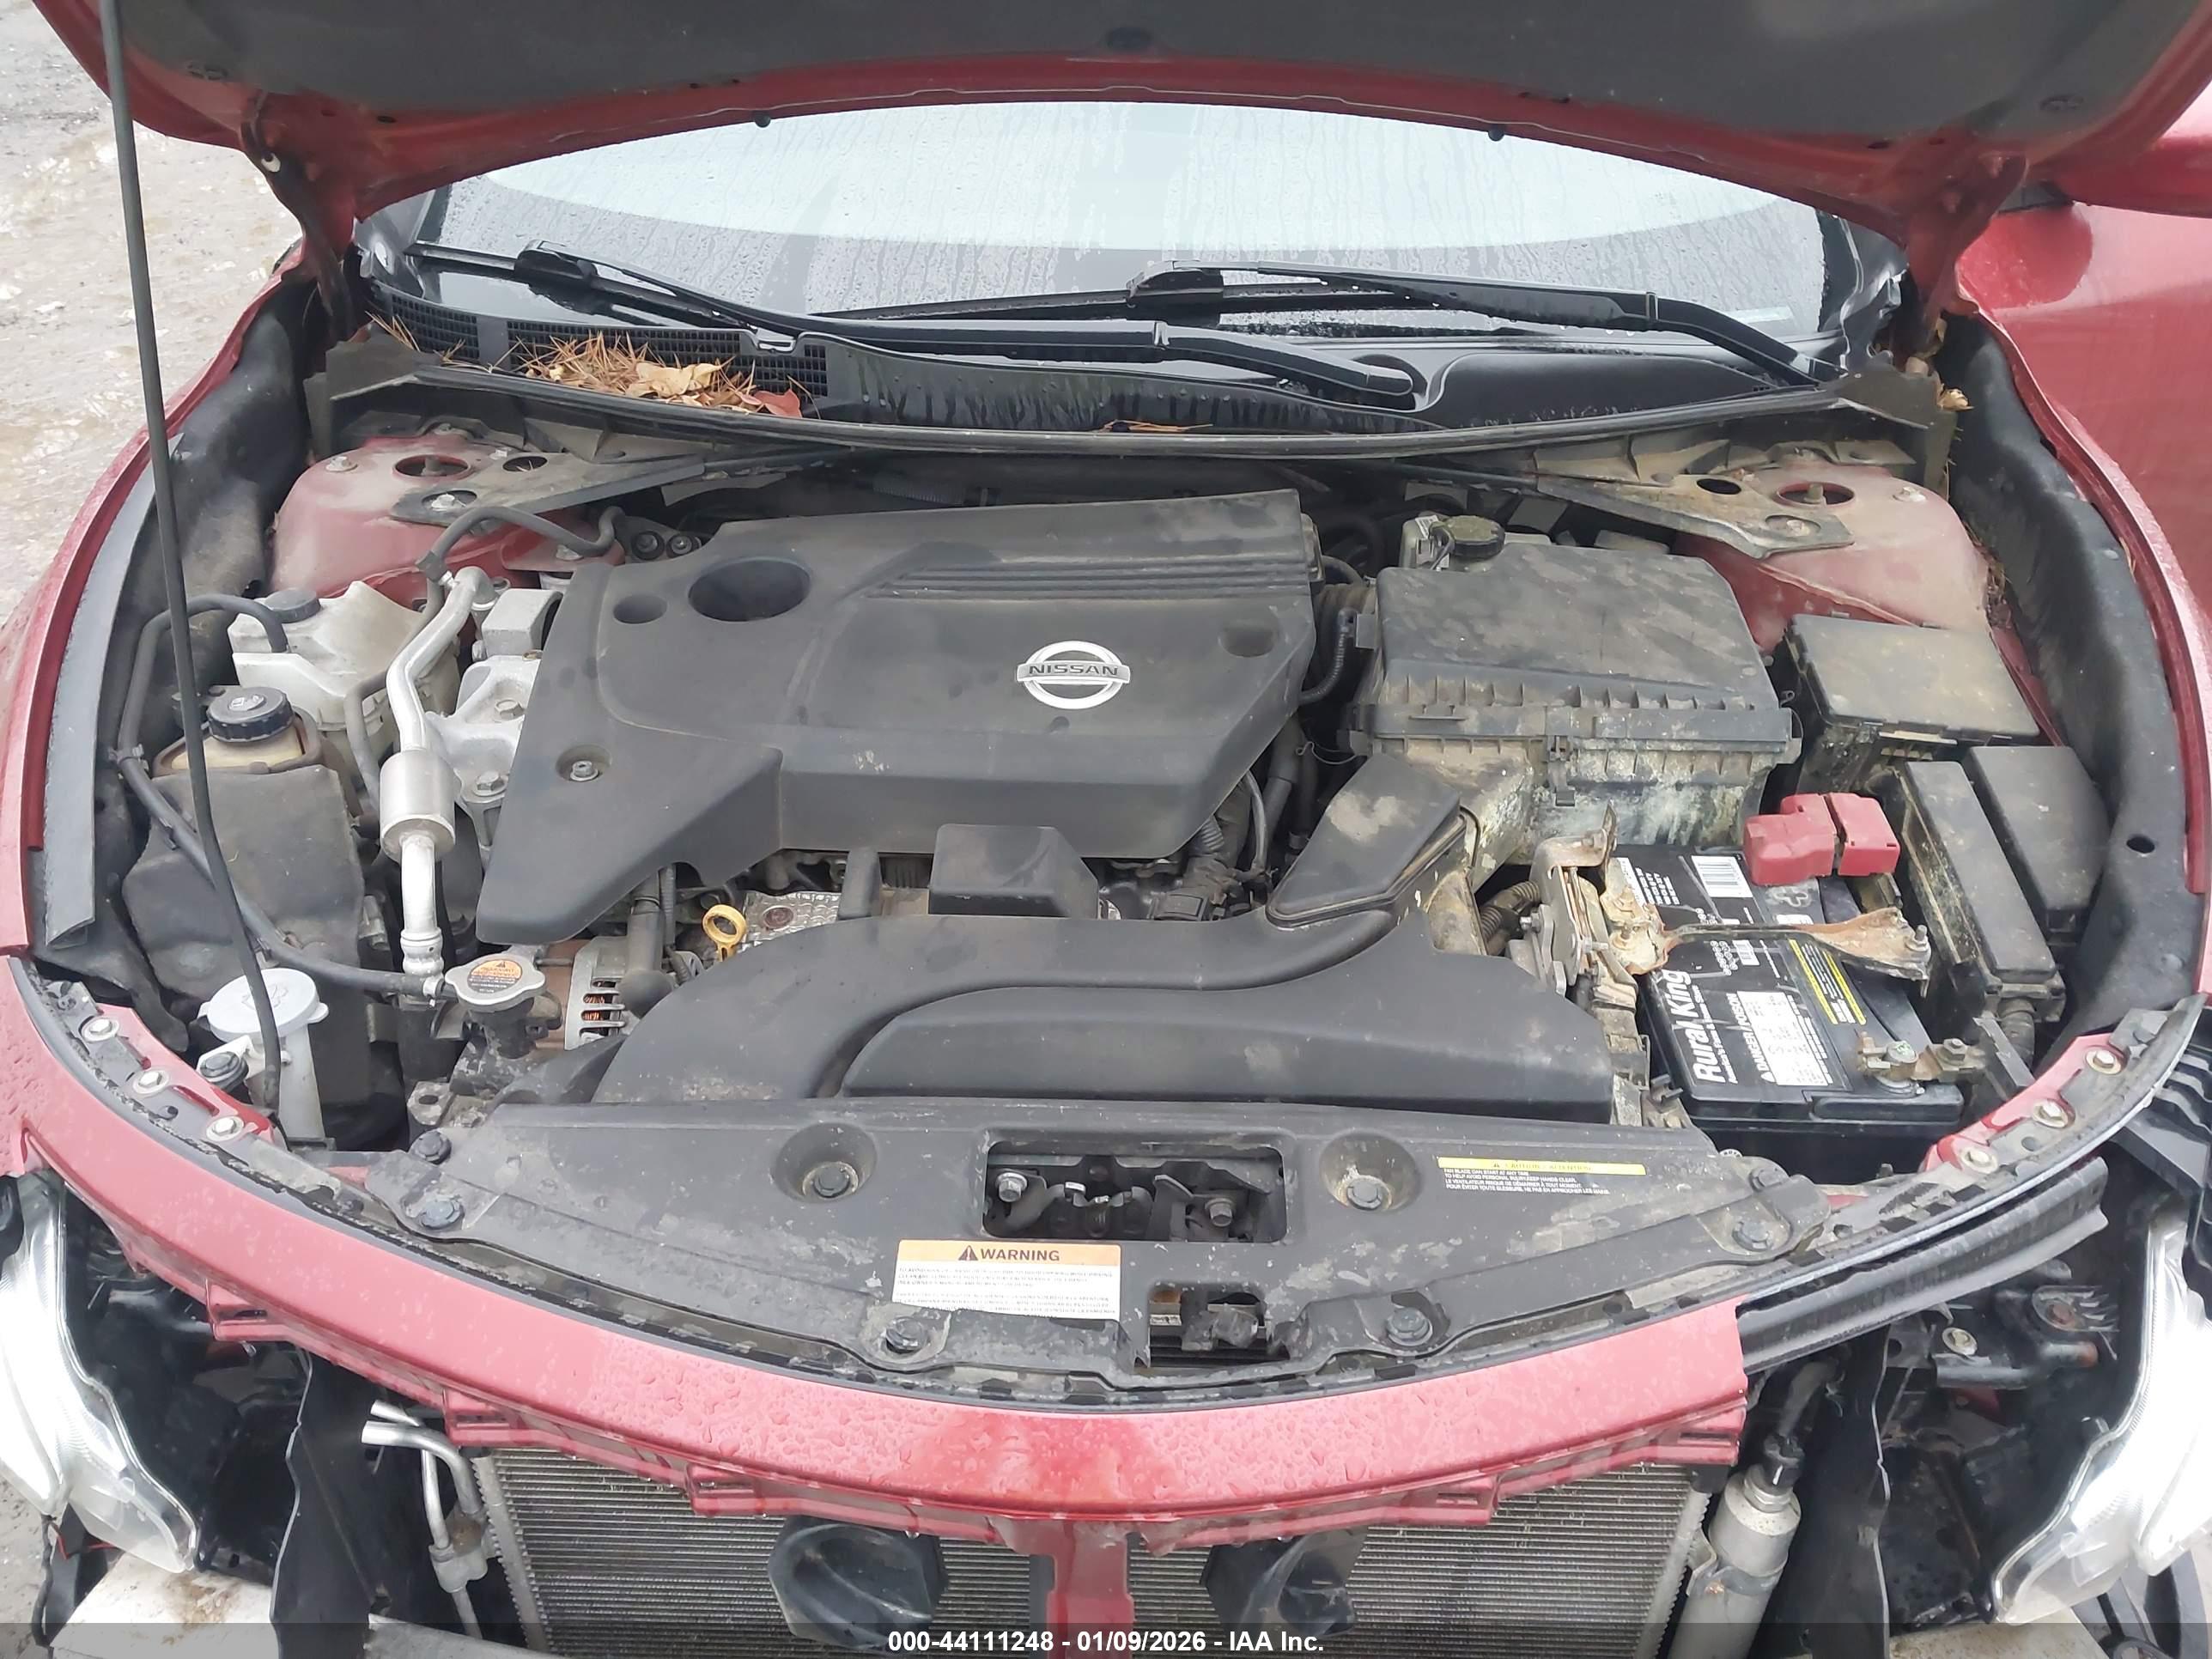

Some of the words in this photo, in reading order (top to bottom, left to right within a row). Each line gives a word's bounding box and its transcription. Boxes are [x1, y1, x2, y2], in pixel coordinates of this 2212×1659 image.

[1029, 664, 1119, 676] NISSAN
[1662, 969, 1699, 1018] King
[1676, 1020, 1726, 1083] Rural
[981, 1249, 1060, 1261] WARNING
